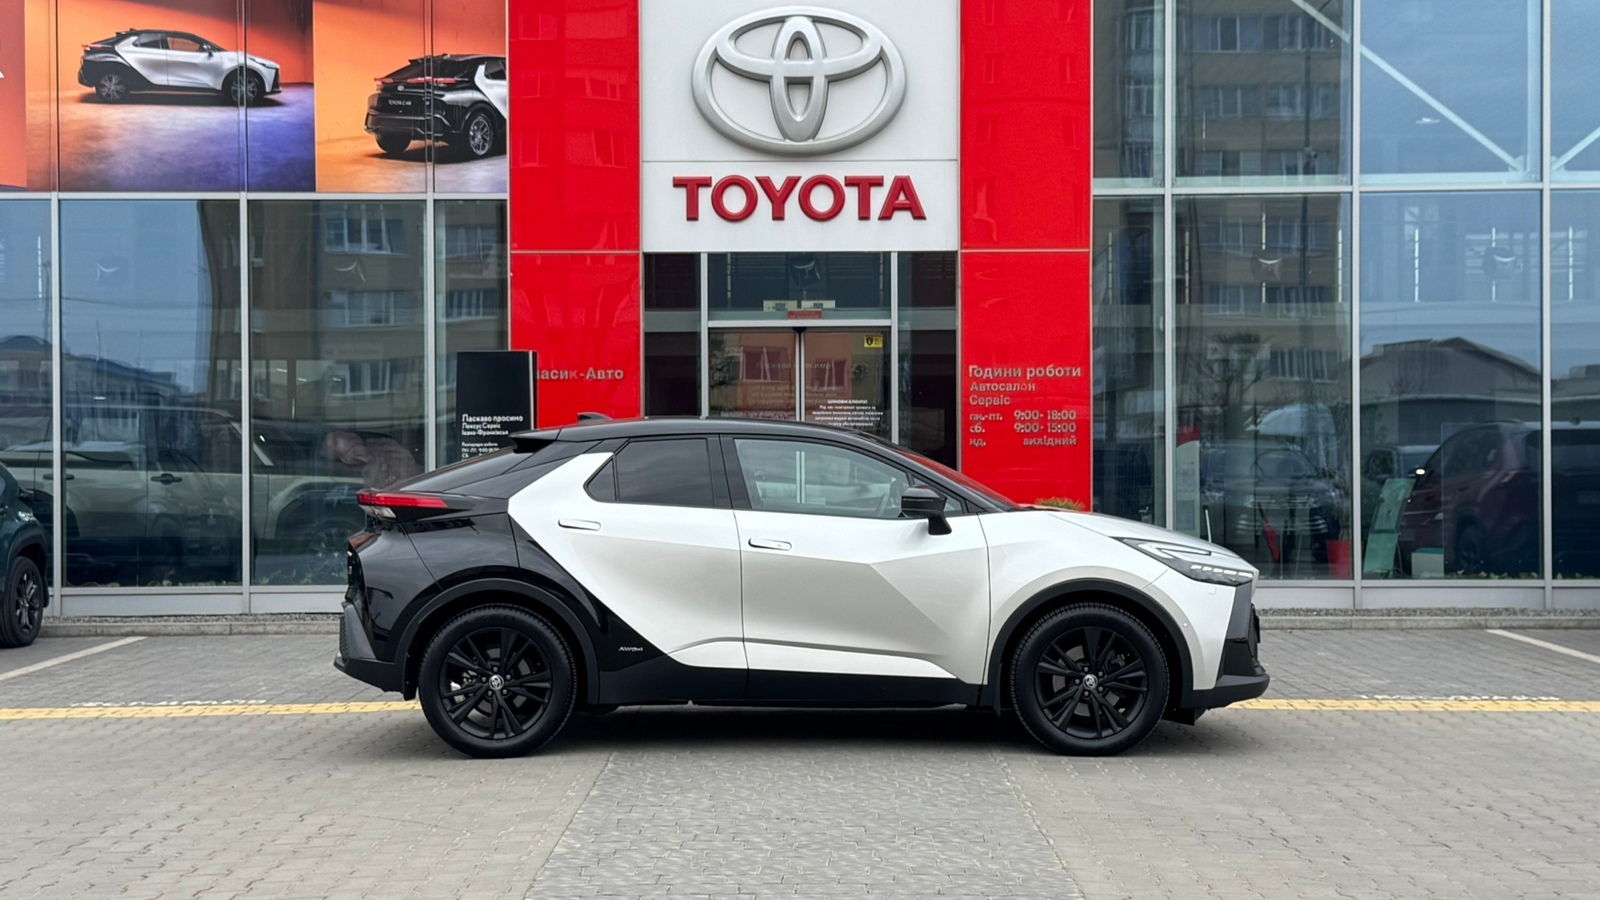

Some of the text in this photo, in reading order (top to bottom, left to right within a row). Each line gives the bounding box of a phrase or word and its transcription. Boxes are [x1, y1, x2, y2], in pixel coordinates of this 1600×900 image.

[673, 174, 927, 223] TOYOTA
[968, 364, 1081, 379] Години роботи
[970, 382, 1036, 392] Автосалон
[969, 395, 1011, 407] Сервіс
[969, 422, 986, 433] сб.
[969, 435, 1077, 447] нд. вихідний
